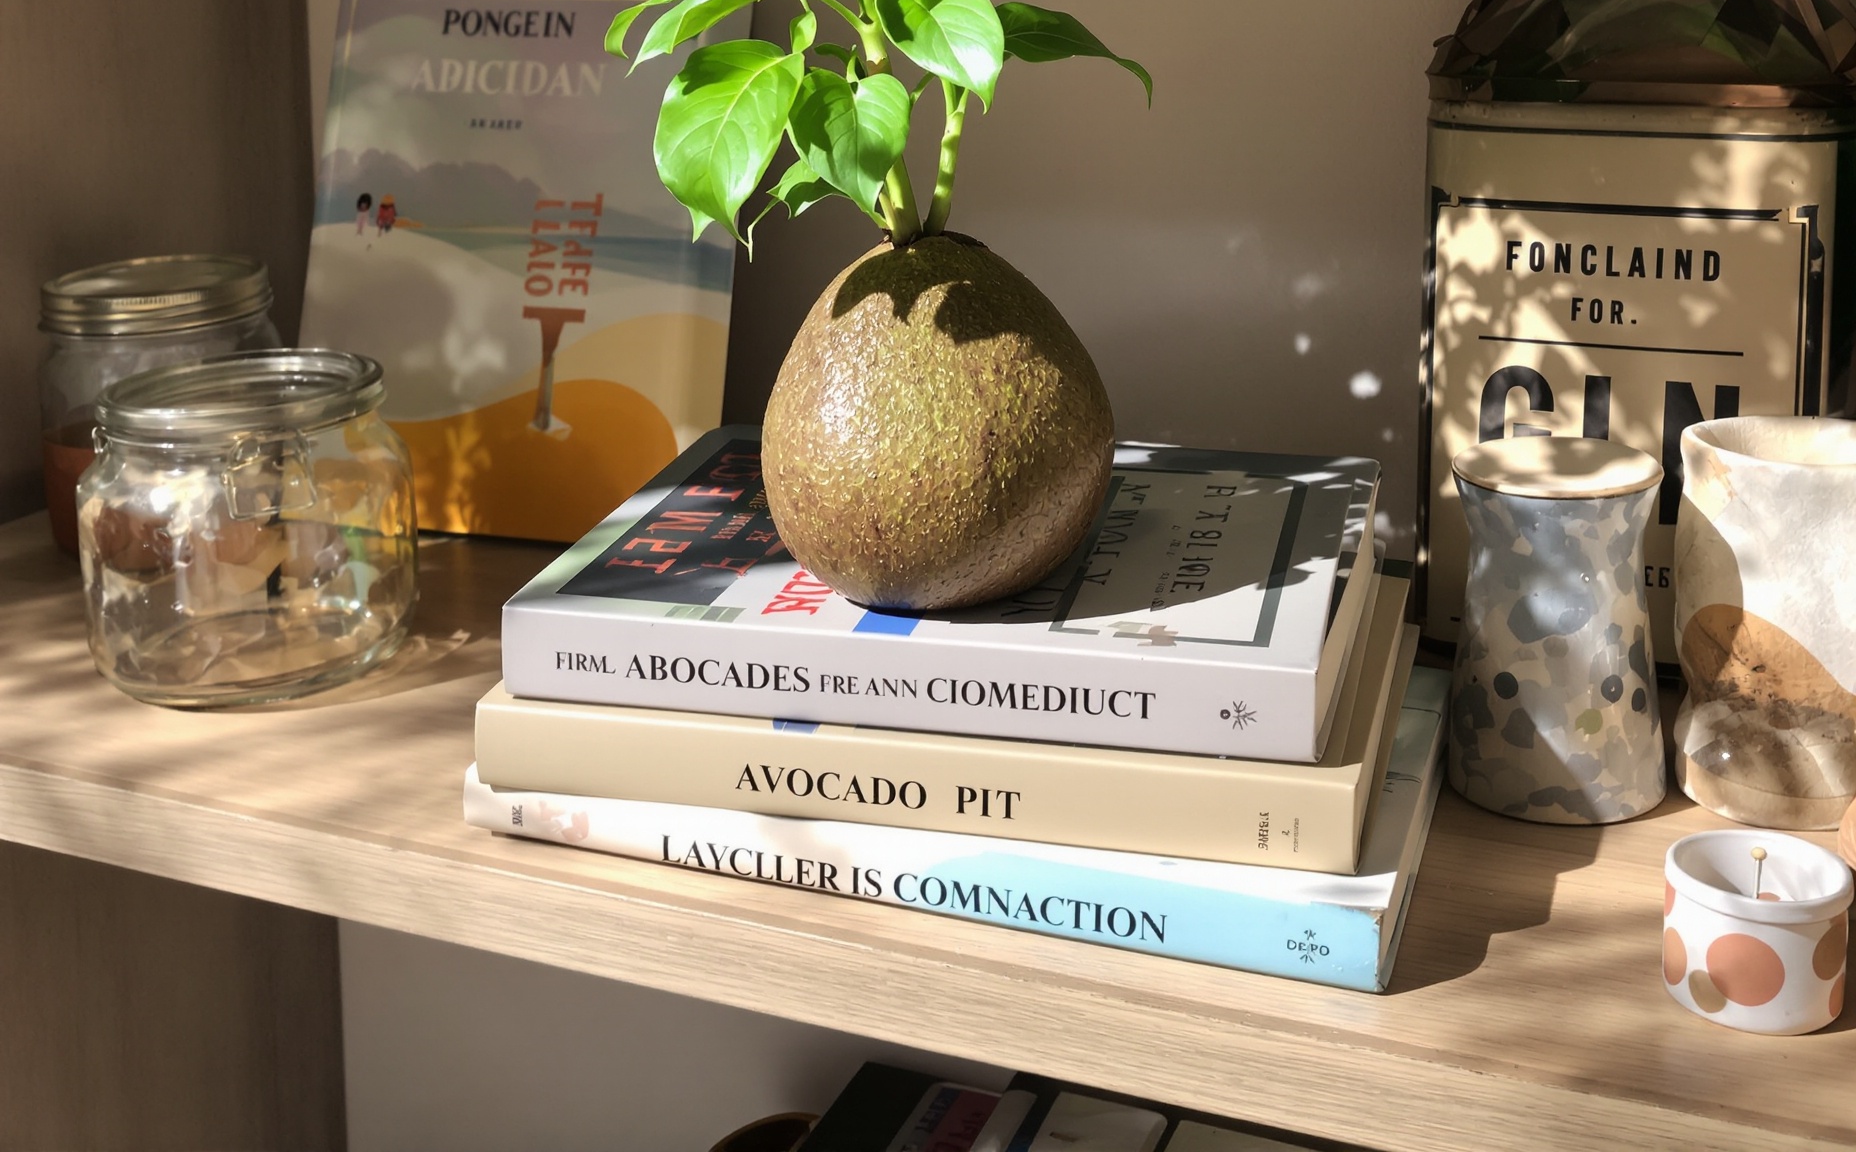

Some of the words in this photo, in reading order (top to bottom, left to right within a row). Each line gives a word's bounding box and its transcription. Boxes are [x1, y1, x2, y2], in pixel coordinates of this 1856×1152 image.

[441, 9, 577, 38] PONGEIN
[1505, 239, 1722, 282] FONCLAIND
[1570, 296, 1638, 325] FOR.
[625, 654, 811, 694] ABOCADES
[865, 677, 918, 699] ANN
[926, 677, 1156, 720] CIOMEDIUCT
[735, 762, 928, 811] AVOCADO
[955, 785, 1021, 820] PIT
[661, 834, 840, 891] LAYCLLER
[851, 866, 883, 898] IS
[893, 872, 1168, 944] COMNACTION
